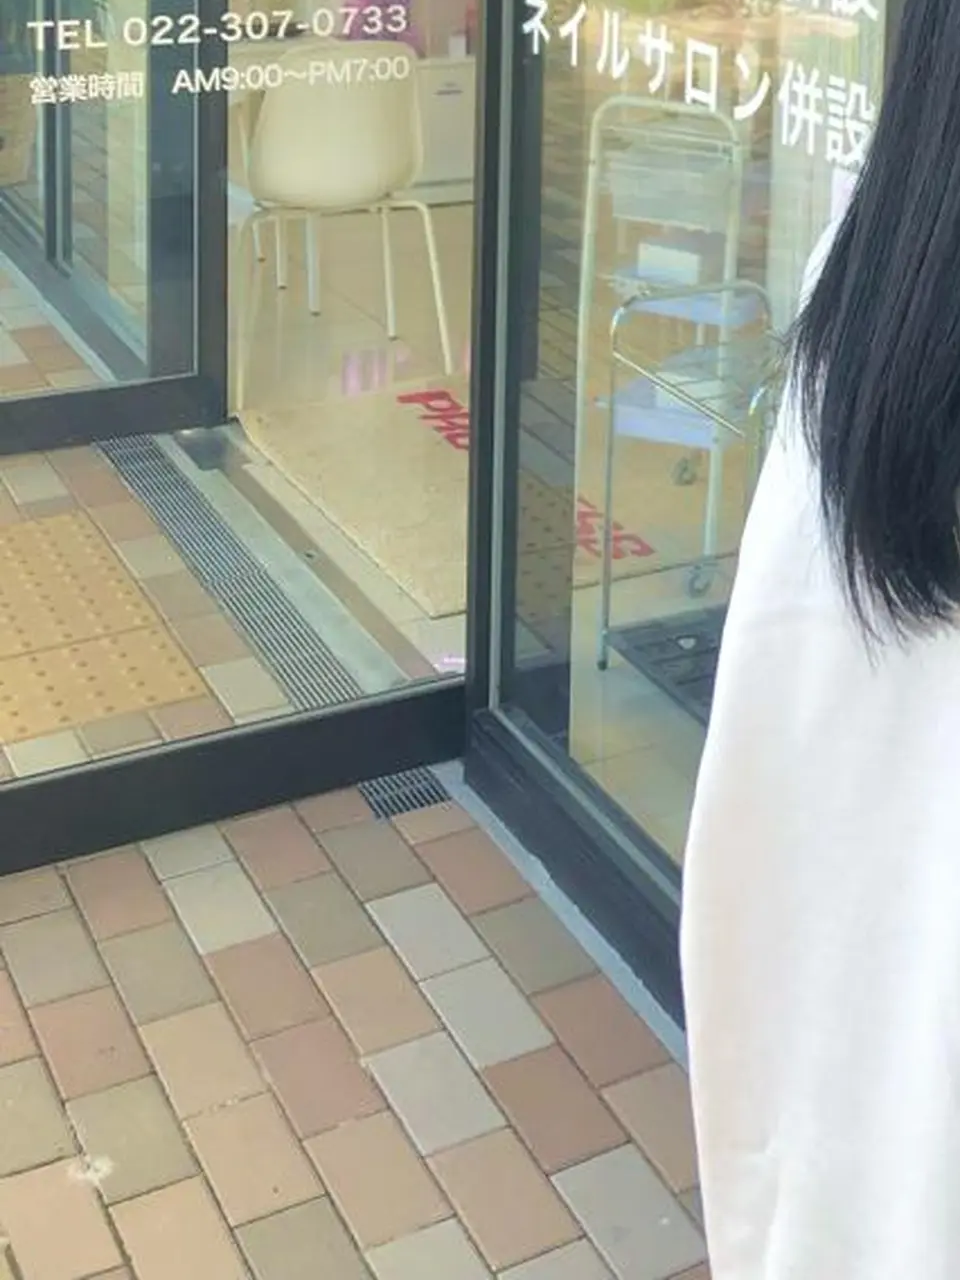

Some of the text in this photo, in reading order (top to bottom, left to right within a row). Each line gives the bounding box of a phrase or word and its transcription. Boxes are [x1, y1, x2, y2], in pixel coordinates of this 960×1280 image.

[27, 5, 408, 51] TEL 022-307-0733
[29, 72, 145, 105] 営業時間
